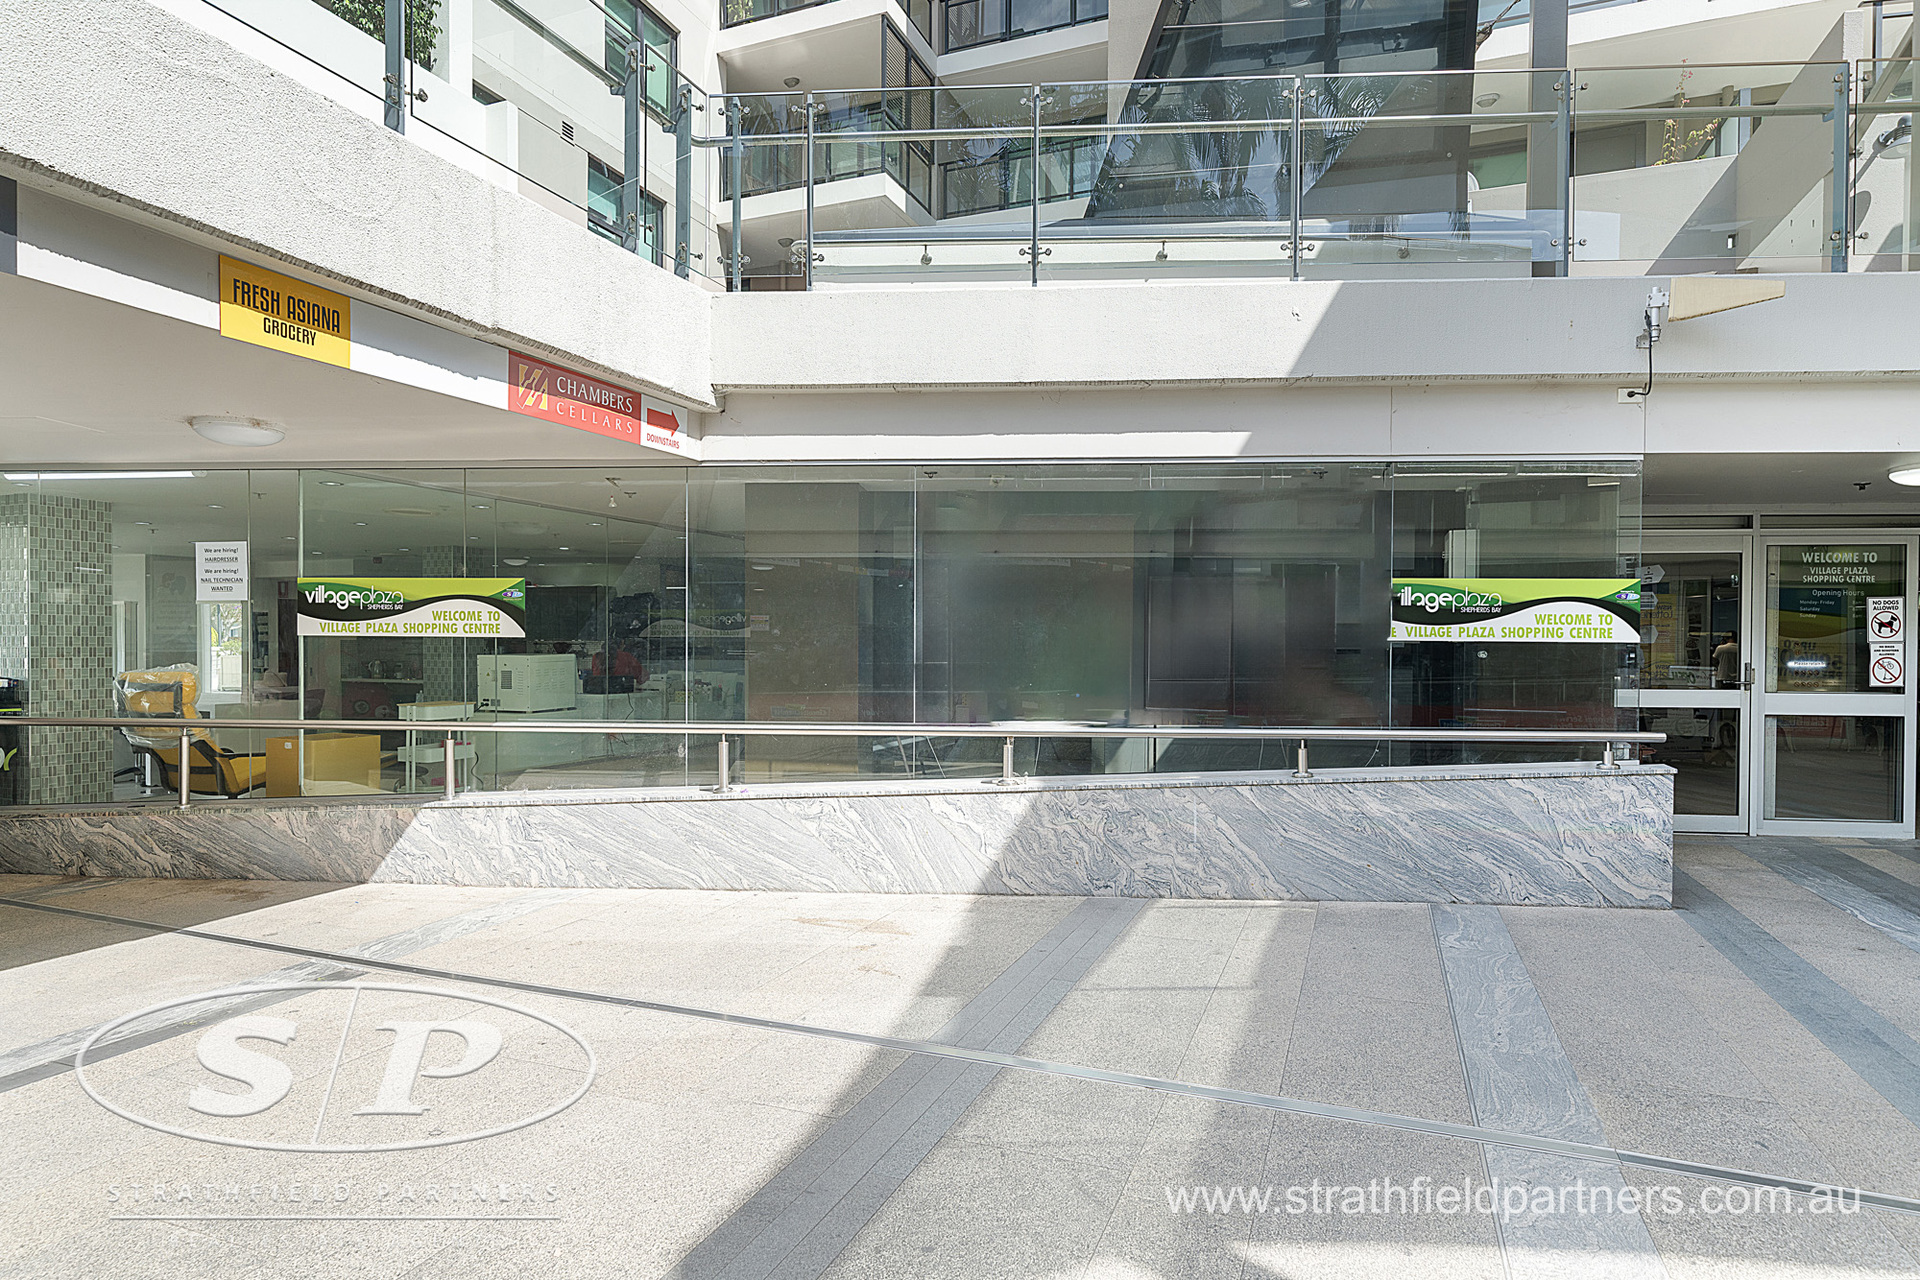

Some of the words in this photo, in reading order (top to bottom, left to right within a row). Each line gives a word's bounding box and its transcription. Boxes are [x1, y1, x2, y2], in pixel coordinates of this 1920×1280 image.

[233, 278, 280, 316] FRESH
[287, 296, 340, 333] ASIANA
[263, 317, 316, 346] GROCERY
[556, 376, 633, 413] CHAMBERS
[556, 402, 633, 434] CELLARS
[646, 432, 680, 449] DOWNSTAIRS
[1802, 552, 1859, 563] WELCOME
[1862, 552, 1878, 563] TO
[1802, 575, 1844, 583] SHOPPING
[1846, 575, 1876, 583] CENTRE
[1397, 586, 1502, 612] illageplaza
[432, 610, 482, 622] WELCOME
[487, 610, 500, 622] TO
[1534, 614, 1592, 625] WELCOME
[1598, 614, 1613, 625] TO
[320, 622, 361, 633] VILLAGE
[366, 622, 398, 633] PLAZA
[402, 622, 458, 634] SHOPPING
[462, 622, 500, 634] CENTRE
[1405, 626, 1452, 638] VILLAGE
[1458, 626, 1496, 638] PLAZA
[1500, 627, 1564, 638] SHOPPING
[1569, 627, 1613, 638] CENTRE
